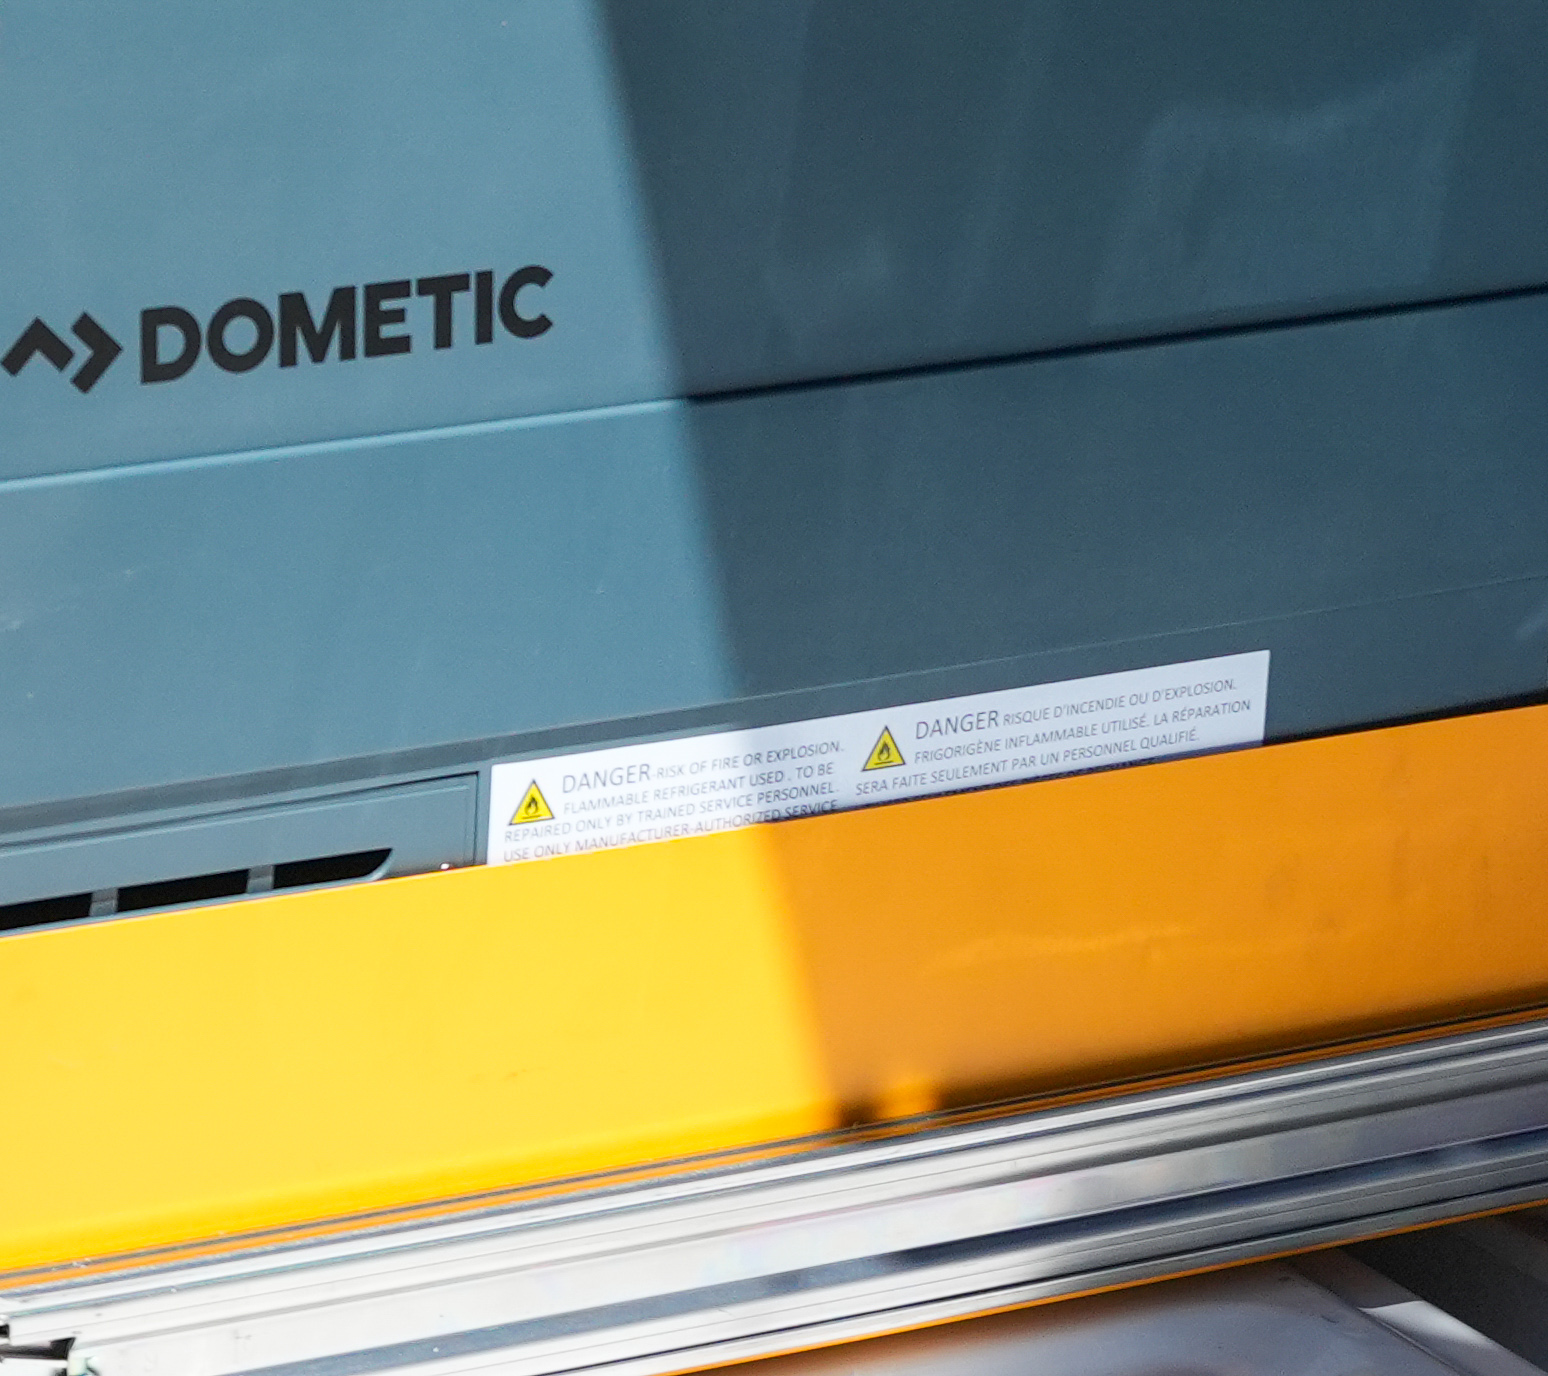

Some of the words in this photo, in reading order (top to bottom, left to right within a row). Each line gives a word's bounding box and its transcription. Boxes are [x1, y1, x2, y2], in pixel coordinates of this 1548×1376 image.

[140, 265, 555, 386] DOMETIC
[914, 738, 1001, 764] FRIGORIGÈNE
[1005, 723, 1097, 749] INFLAMMABLE
[1101, 713, 1150, 734] UTILISÉ.
[1153, 714, 1169, 727] LA
[1172, 700, 1251, 722] RÉPARATION
[916, 710, 999, 740] DANGER
[1003, 706, 1050, 726] RISQUE
[1053, 695, 1126, 718] D'INCENDIE
[1129, 692, 1149, 706] OU
[1152, 679, 1237, 702] D'EXPLOSION.
[689, 760, 707, 775] OF
[711, 755, 740, 771] FIRE
[743, 752, 763, 767] OR
[766, 741, 844, 763] EXPLOSION.
[855, 778, 889, 796] SERA
[892, 772, 927, 789] FAITE
[930, 760, 1007, 784] SEULEMENT
[1011, 755, 1036, 771] PAR
[1040, 751, 1060, 766] UN
[1062, 739, 1137, 762] PERSONNEL
[504, 823, 571, 843] REPAIRED
[575, 816, 611, 833] ONLY
[617, 813, 632, 826] BY
[638, 803, 695, 823] TRAINED
[699, 793, 753, 814] SERVICE
[563, 791, 649, 815] FLAMMABLE
[654, 776, 746, 801] REFRIGERANT
[796, 766, 814, 780] TO
[817, 762, 835, 776] BE
[504, 847, 530, 863] USE
[533, 842, 570, 859] ONLY
[785, 798, 839, 819] SERVICE
